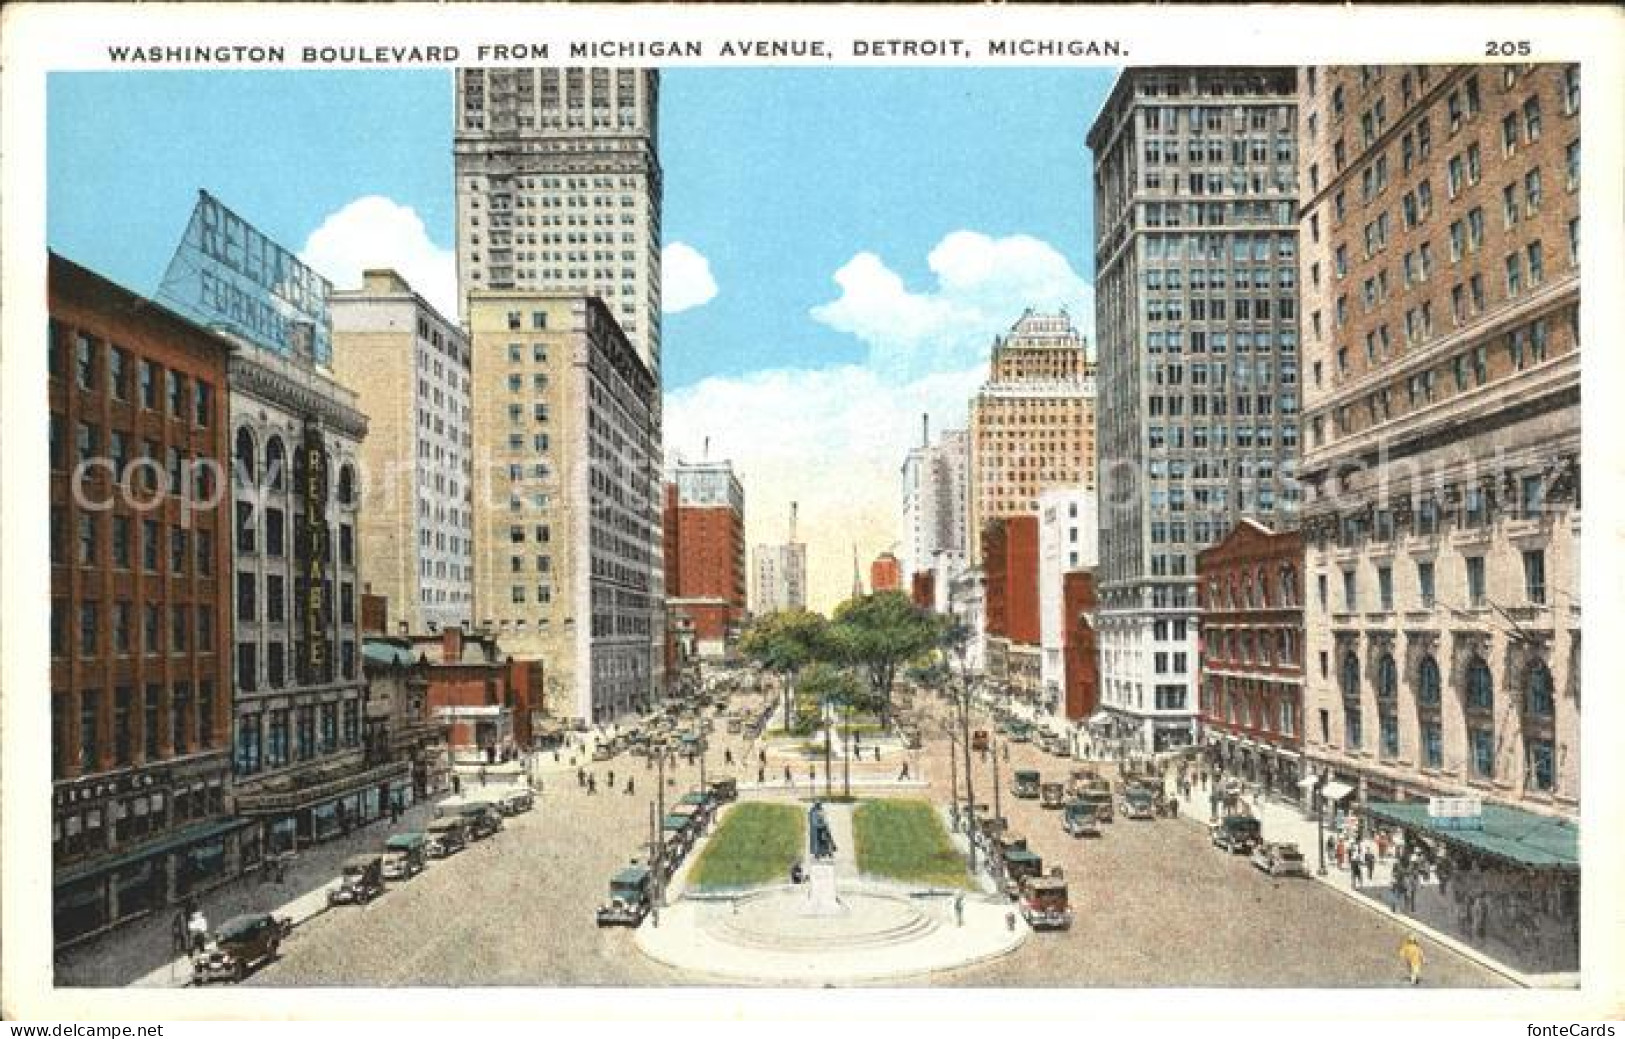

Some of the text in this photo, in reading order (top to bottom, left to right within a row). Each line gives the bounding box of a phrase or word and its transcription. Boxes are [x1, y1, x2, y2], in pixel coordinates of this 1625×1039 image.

[108, 39, 1129, 62] WASHINGTON BOULEVARD FROM MICHIGAN AVENUE, DETROIT, MICHIGAN.
[1485, 41, 1531, 57] 205
[308, 449, 325, 667] RELIABLE
